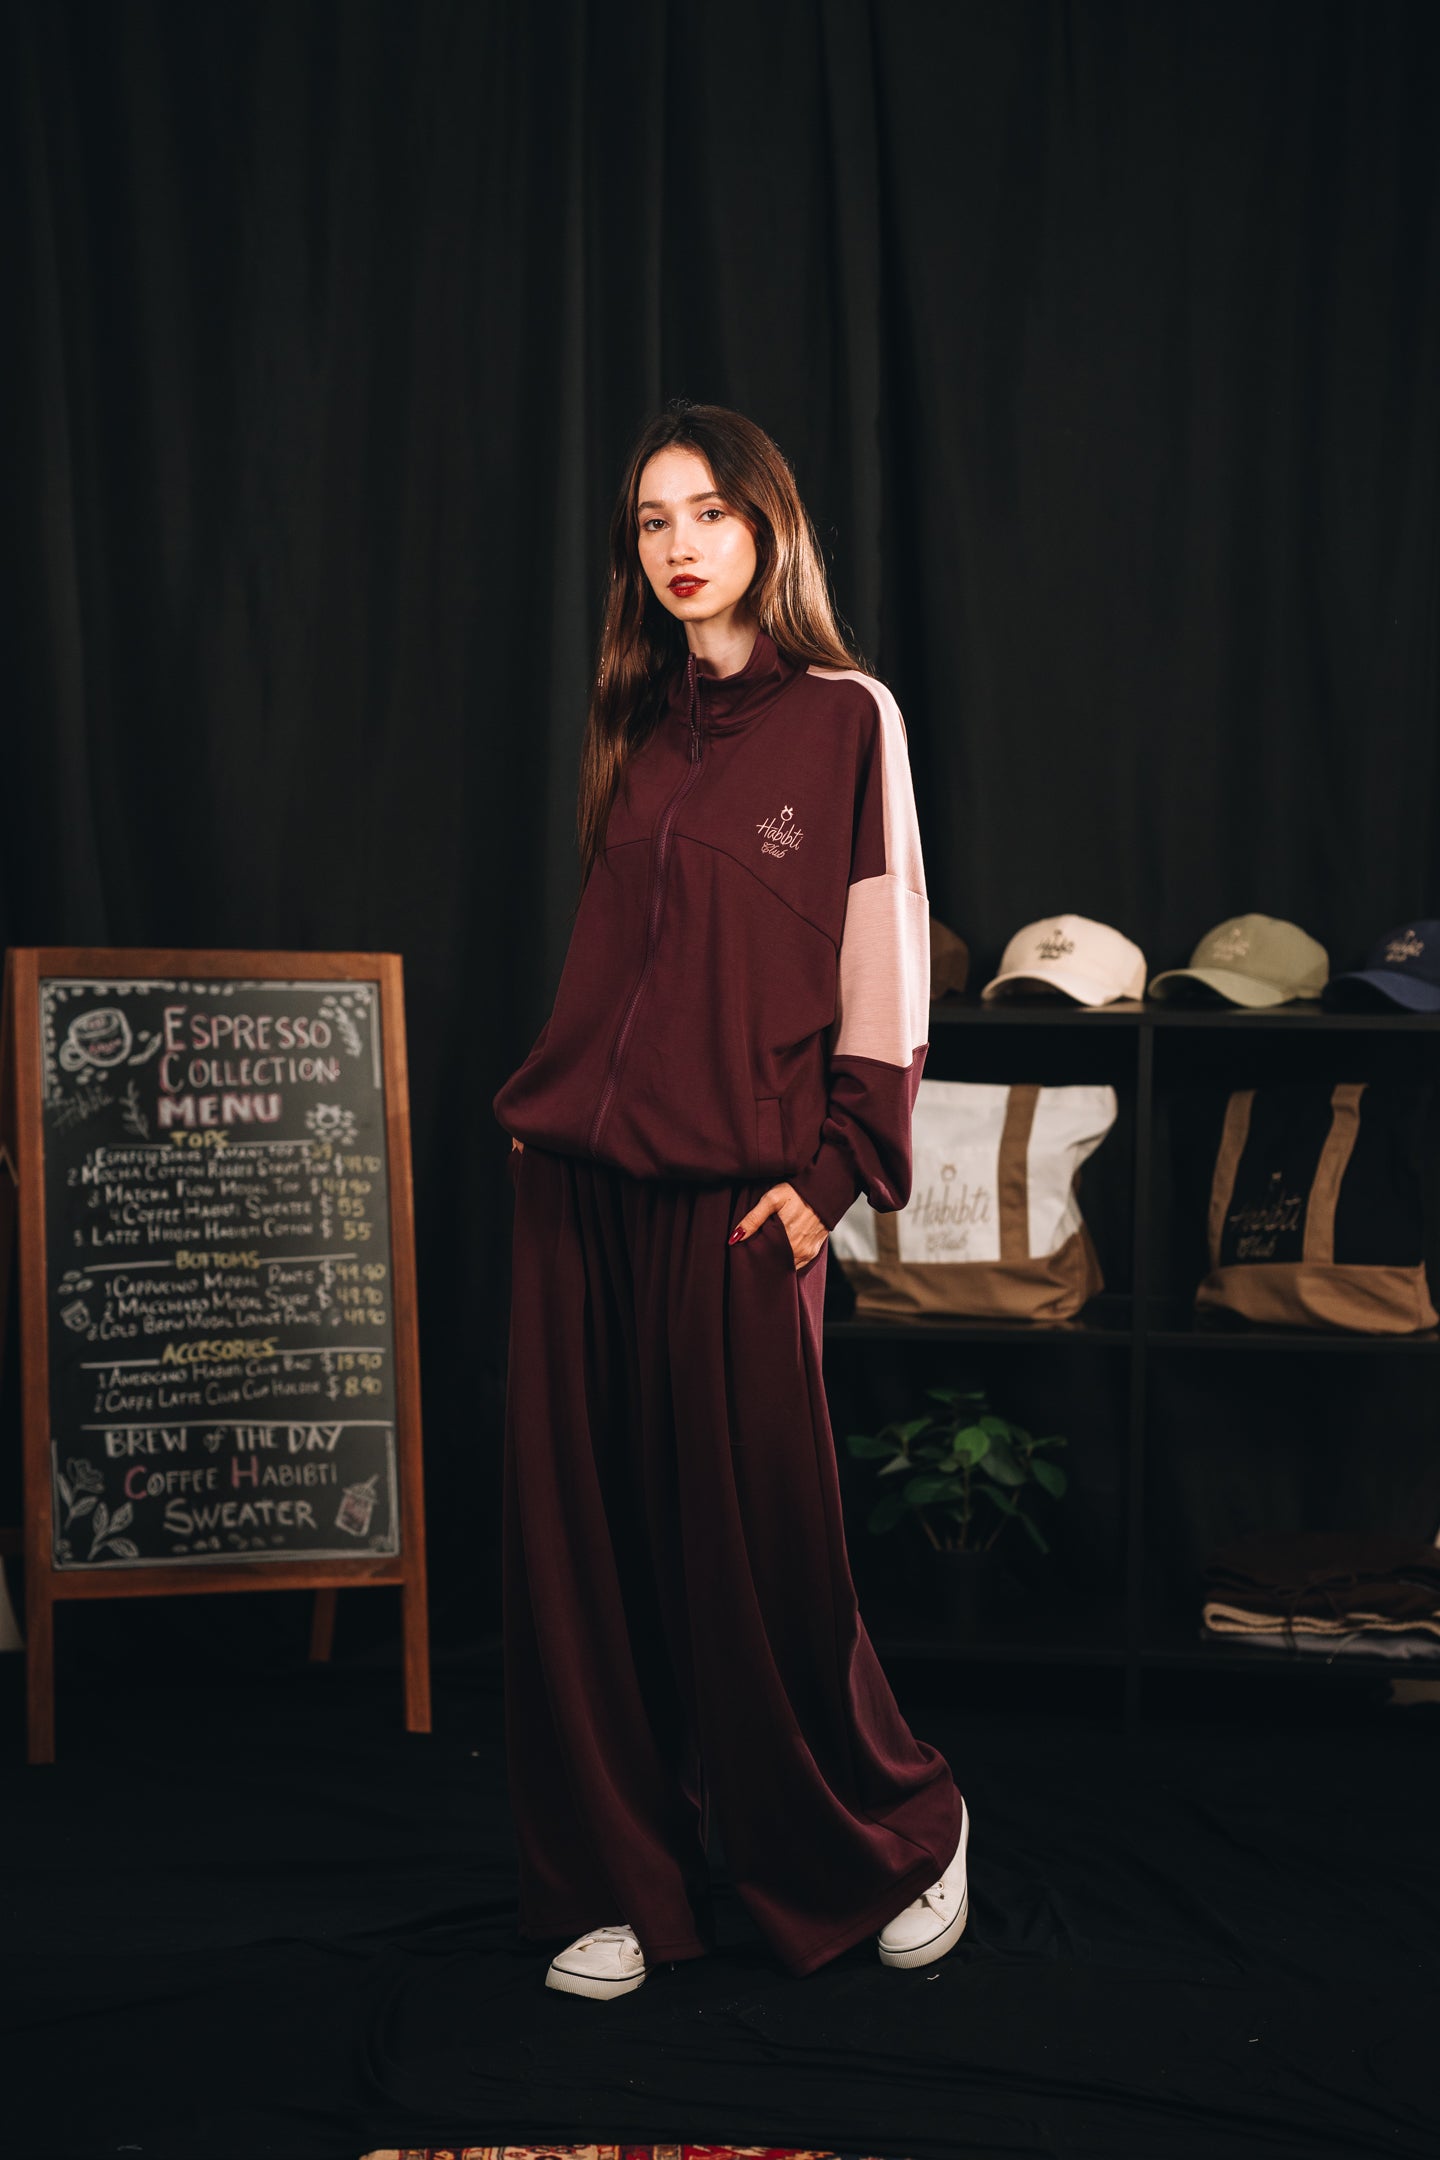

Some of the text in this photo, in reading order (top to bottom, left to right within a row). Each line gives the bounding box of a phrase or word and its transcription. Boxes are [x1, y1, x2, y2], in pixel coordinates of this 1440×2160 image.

[756, 817, 804, 851] Habibti
[164, 1005, 331, 1051] ESPRESSO
[159, 1053, 337, 1093] COLLECTION
[157, 1094, 283, 1127] MENU
[170, 1130, 229, 1149] TOPS
[81, 1164, 142, 1185] MOCHA
[104, 1182, 169, 1206] MATCHA
[272, 1177, 301, 1194] TOP
[908, 1183, 992, 1226] Habibti
[122, 1200, 181, 1226] COFFEE
[91, 1226, 141, 1248] LATTE
[176, 1250, 261, 1271] BOTTOMS
[162, 1336, 280, 1366] ACCESORIES
[105, 1426, 187, 1457] BREW
[234, 1425, 279, 1452] THE
[288, 1424, 343, 1454] DAY
[124, 1455, 338, 1500] COFFEE HABIBTI
[163, 1497, 317, 1536] SWEATER
